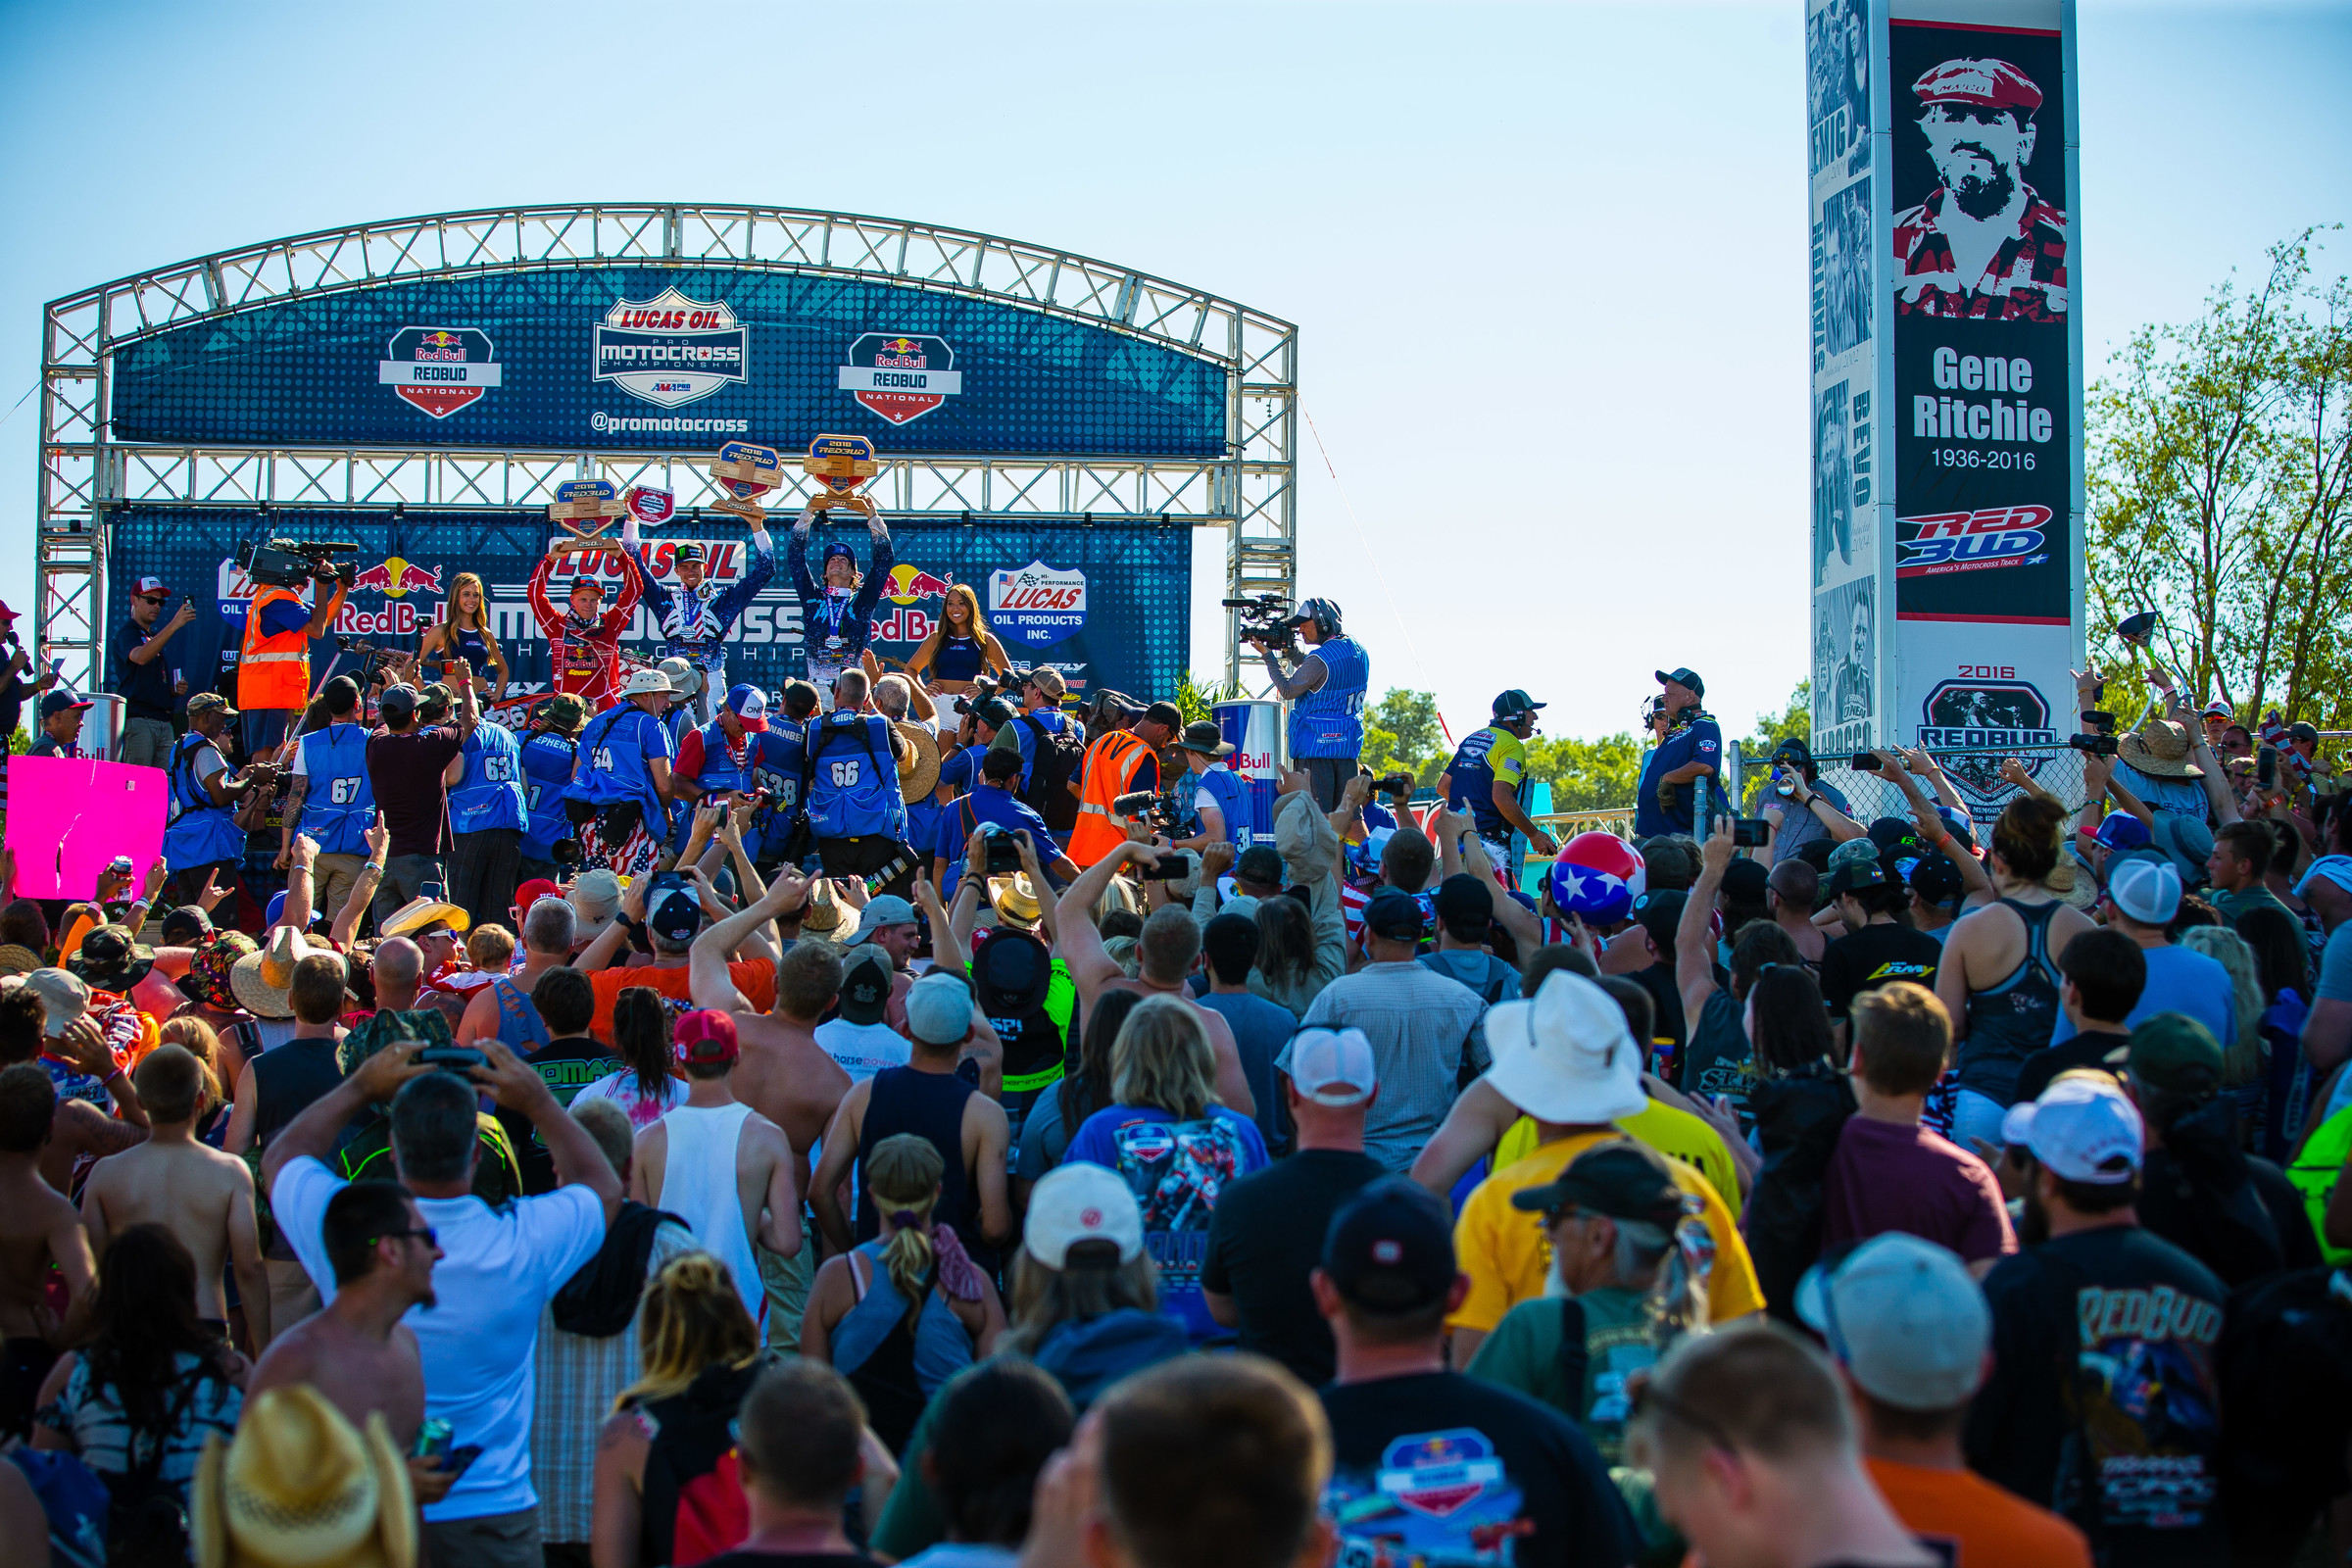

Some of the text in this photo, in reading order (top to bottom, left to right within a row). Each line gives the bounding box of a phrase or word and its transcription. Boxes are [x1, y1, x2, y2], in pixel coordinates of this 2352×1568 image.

[619, 311, 721, 329] LUCAS OIL
[416, 348, 466, 362] Red Bull
[601, 346, 741, 362] MOTOCROSS
[875, 355, 927, 368] Red Bull
[414, 367, 467, 381] REDBUD
[1933, 347, 2033, 392] Gene
[872, 372, 927, 389] REDBUD
[865, 394, 934, 403] NATIONAL
[591, 412, 749, 434] @promotocross
[1914, 395, 2052, 443] Ritchie
[1853, 390, 1870, 508] BEVO
[1932, 448, 2035, 470] 1936-2016
[1896, 505, 2053, 540] RED
[1896, 530, 2045, 567] BUD
[999, 588, 1082, 609] LUCAS
[334, 601, 393, 635] Red
[993, 615, 1083, 625] OIL PRODUCTS
[1027, 630, 1052, 639] INC.
[564, 659, 598, 668] Red Bull
[1958, 665, 2015, 679] 2016
[1920, 728, 2053, 748] REDBUD
[484, 756, 513, 782] 63
[1240, 753, 1270, 769] Bull
[830, 760, 860, 789] 66
[331, 775, 363, 805] 67
